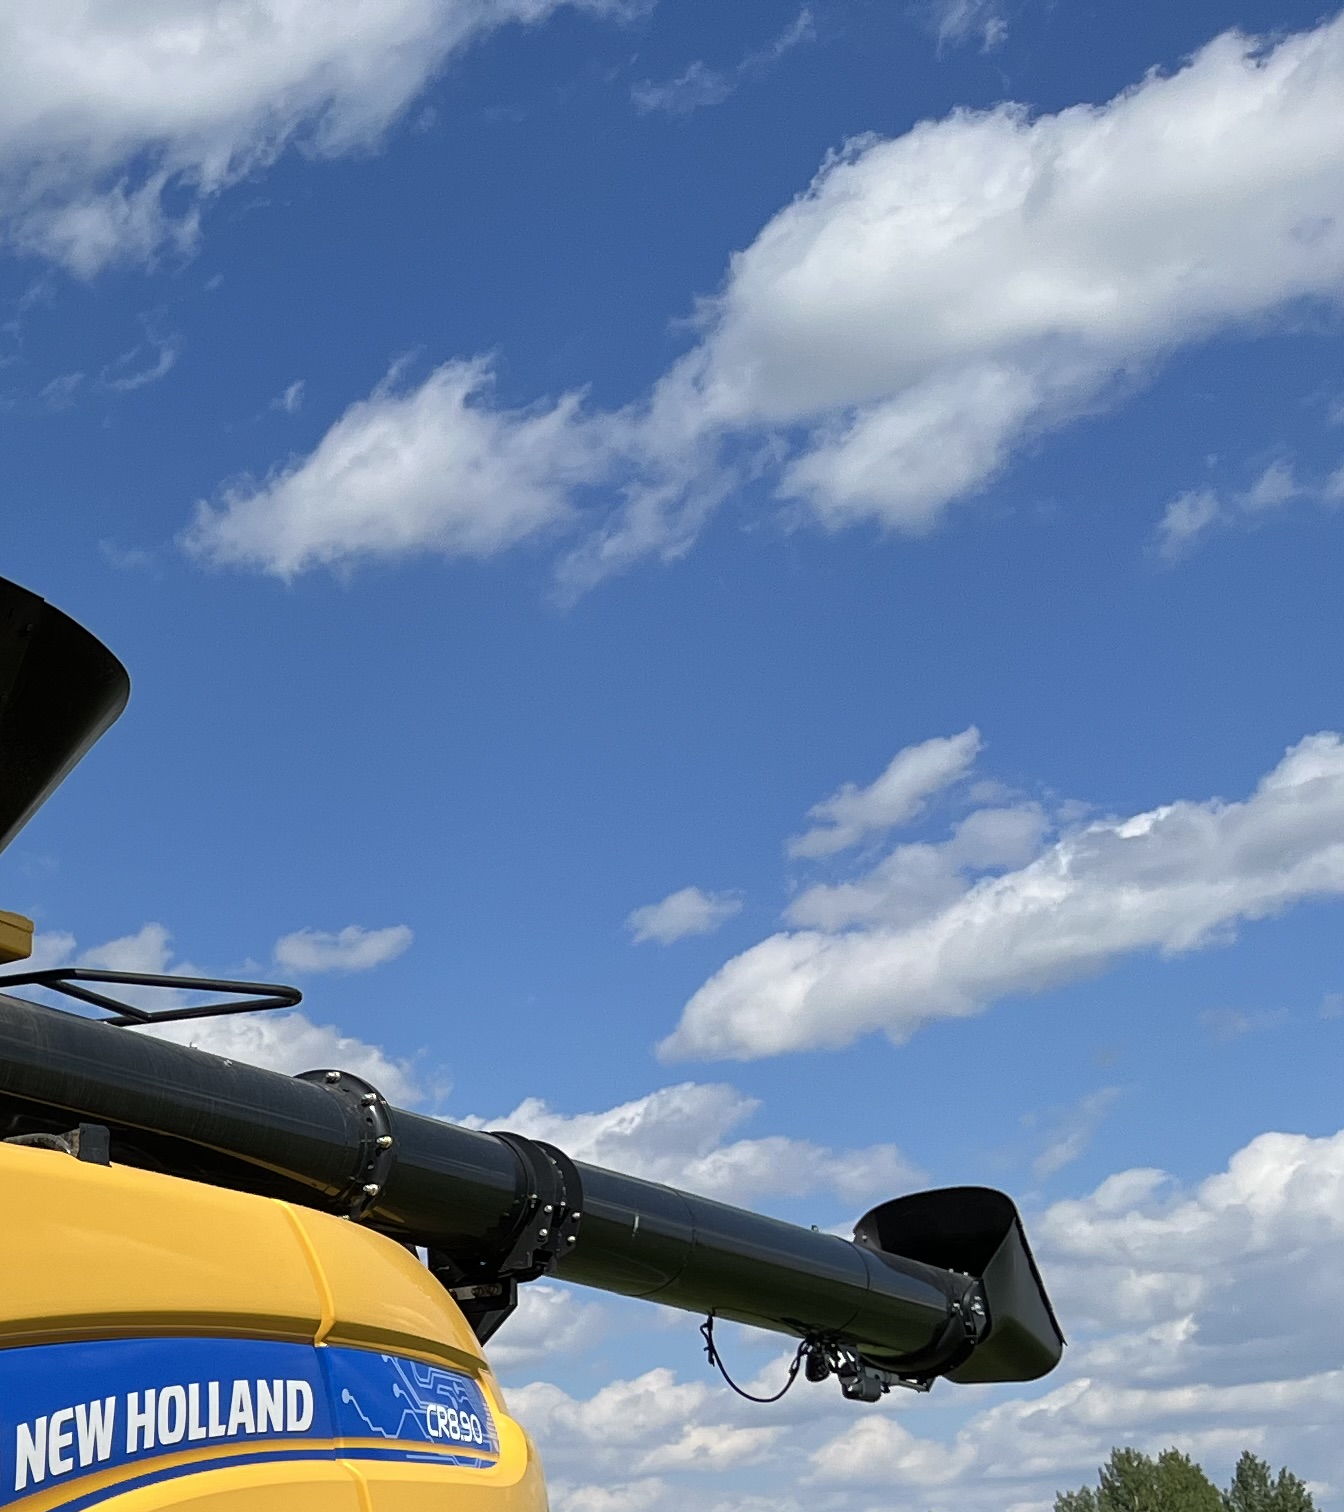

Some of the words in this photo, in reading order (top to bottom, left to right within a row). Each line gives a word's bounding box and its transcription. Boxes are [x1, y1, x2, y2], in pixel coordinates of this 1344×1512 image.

[15, 1395, 117, 1493] NEW
[124, 1378, 315, 1454] HOLLAND
[425, 1403, 484, 1445] CR8.90
